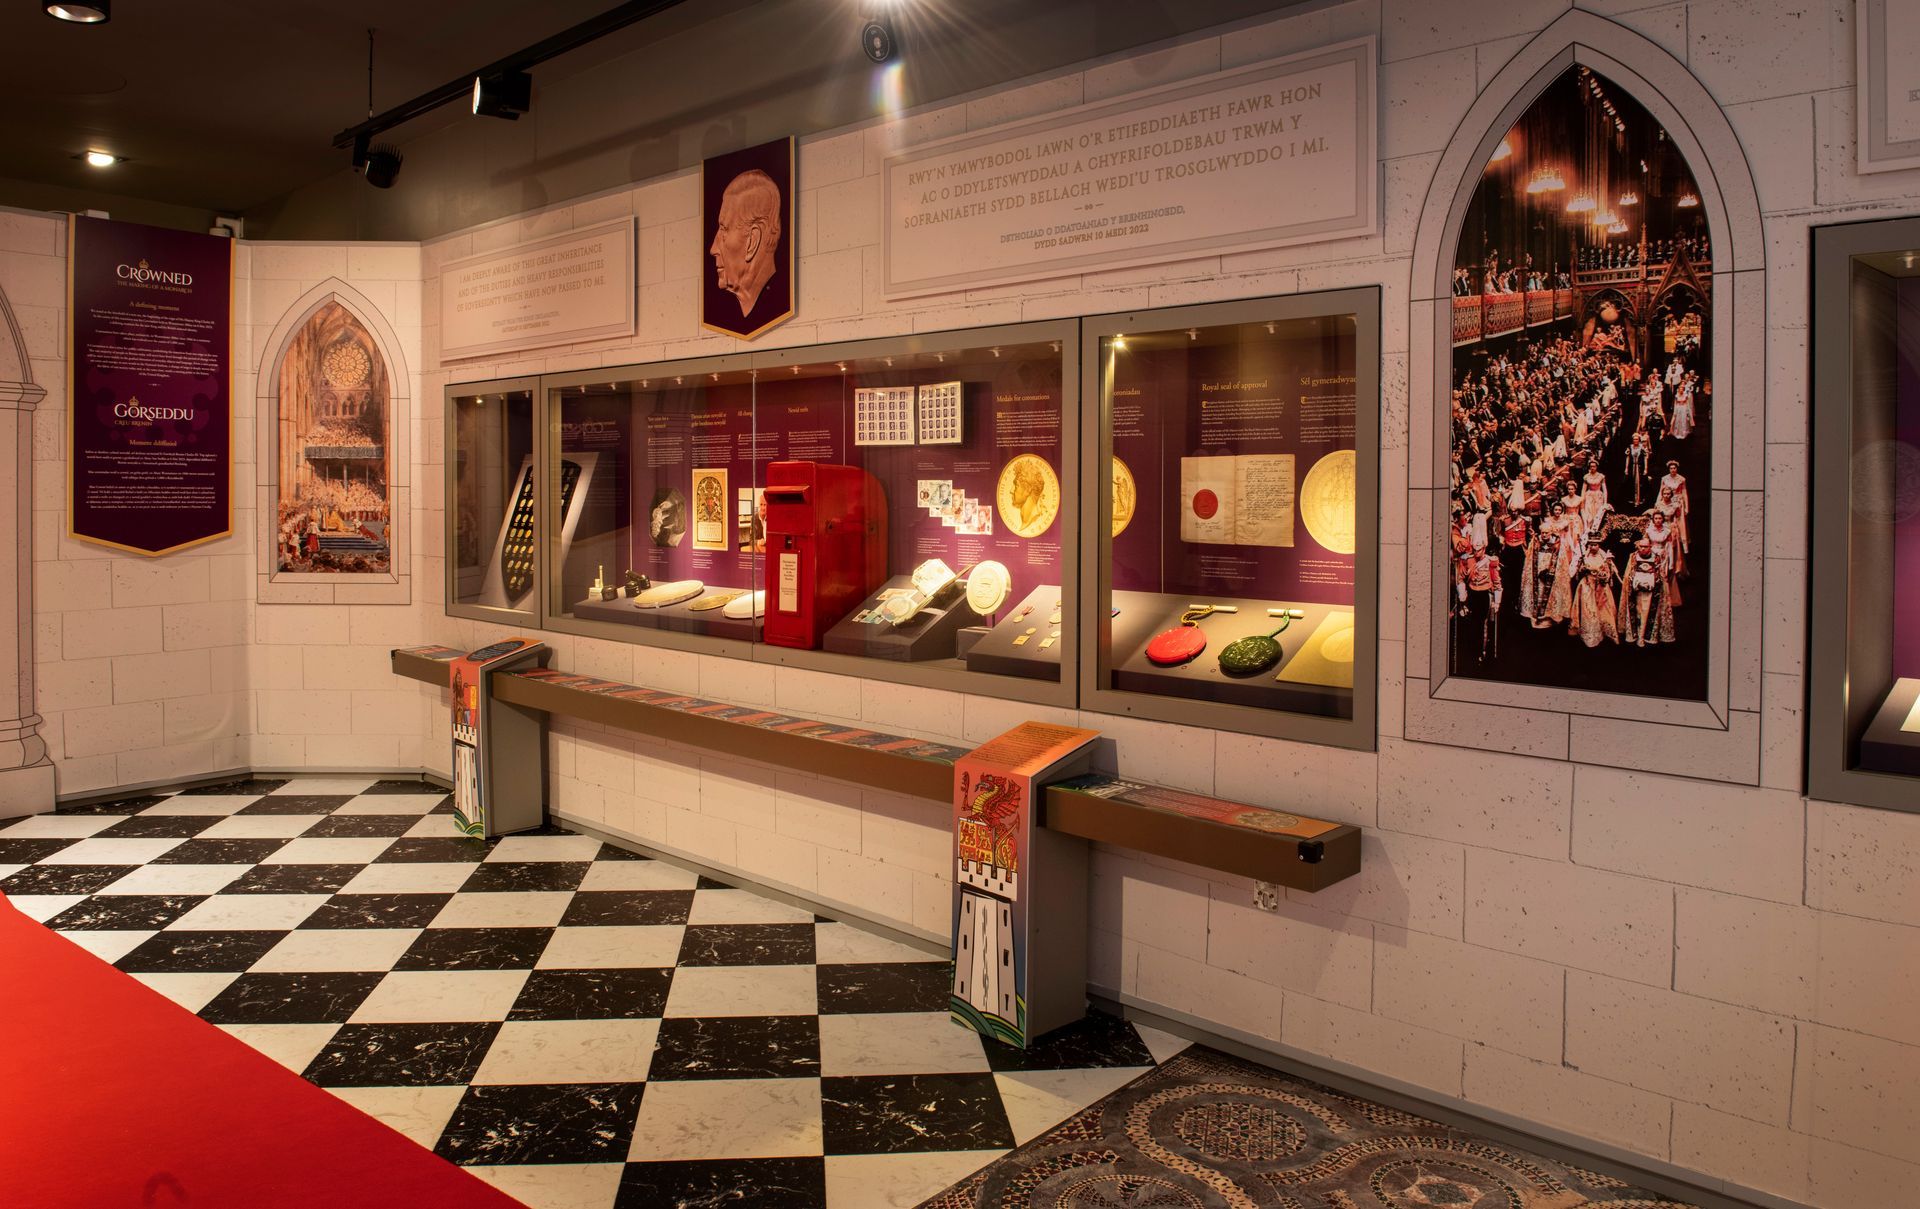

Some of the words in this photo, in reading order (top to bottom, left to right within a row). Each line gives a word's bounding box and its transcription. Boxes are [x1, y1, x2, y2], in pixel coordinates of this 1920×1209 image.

[908, 166, 946, 186] RWY'N
[950, 147, 1033, 177] YMWYBODOL
[1036, 137, 1074, 158] IAWN
[1079, 131, 1103, 149] O'R
[1108, 105, 1221, 143] ETIFEDDIAETH
[1227, 93, 1275, 117] FAWR
[1279, 82, 1323, 106] HON
[920, 190, 938, 205] AC
[940, 186, 950, 201] O
[954, 162, 1070, 198] DDYLETSWYDDAU
[1073, 159, 1084, 174] A
[1087, 130, 1227, 170] CHYFRIFOLDEBAU
[1231, 117, 1285, 142] TRWM
[1290, 113, 1303, 130] Y
[904, 201, 987, 229] SOFRANIAETH
[990, 194, 1026, 213] SYDD
[1030, 180, 1092, 206] BELLACH
[1096, 170, 1151, 194] WEDI'U
[1154, 145, 1284, 183] TROSGLWYDDO
[1289, 141, 1296, 158] I
[1034, 238, 1057, 250] DYDD
[1058, 231, 1094, 247] SADWRN
[1095, 231, 1104, 241] 10
[1105, 226, 1128, 239] MEDI
[1129, 223, 1150, 235] 2022
[1046, 227, 1053, 236] O
[116, 263, 193, 286] CROWNED
[1201, 382, 1219, 393] Royal
[1221, 381, 1231, 390] seal
[1241, 379, 1268, 391] approval
[114, 403, 194, 422] GORSEDDU
